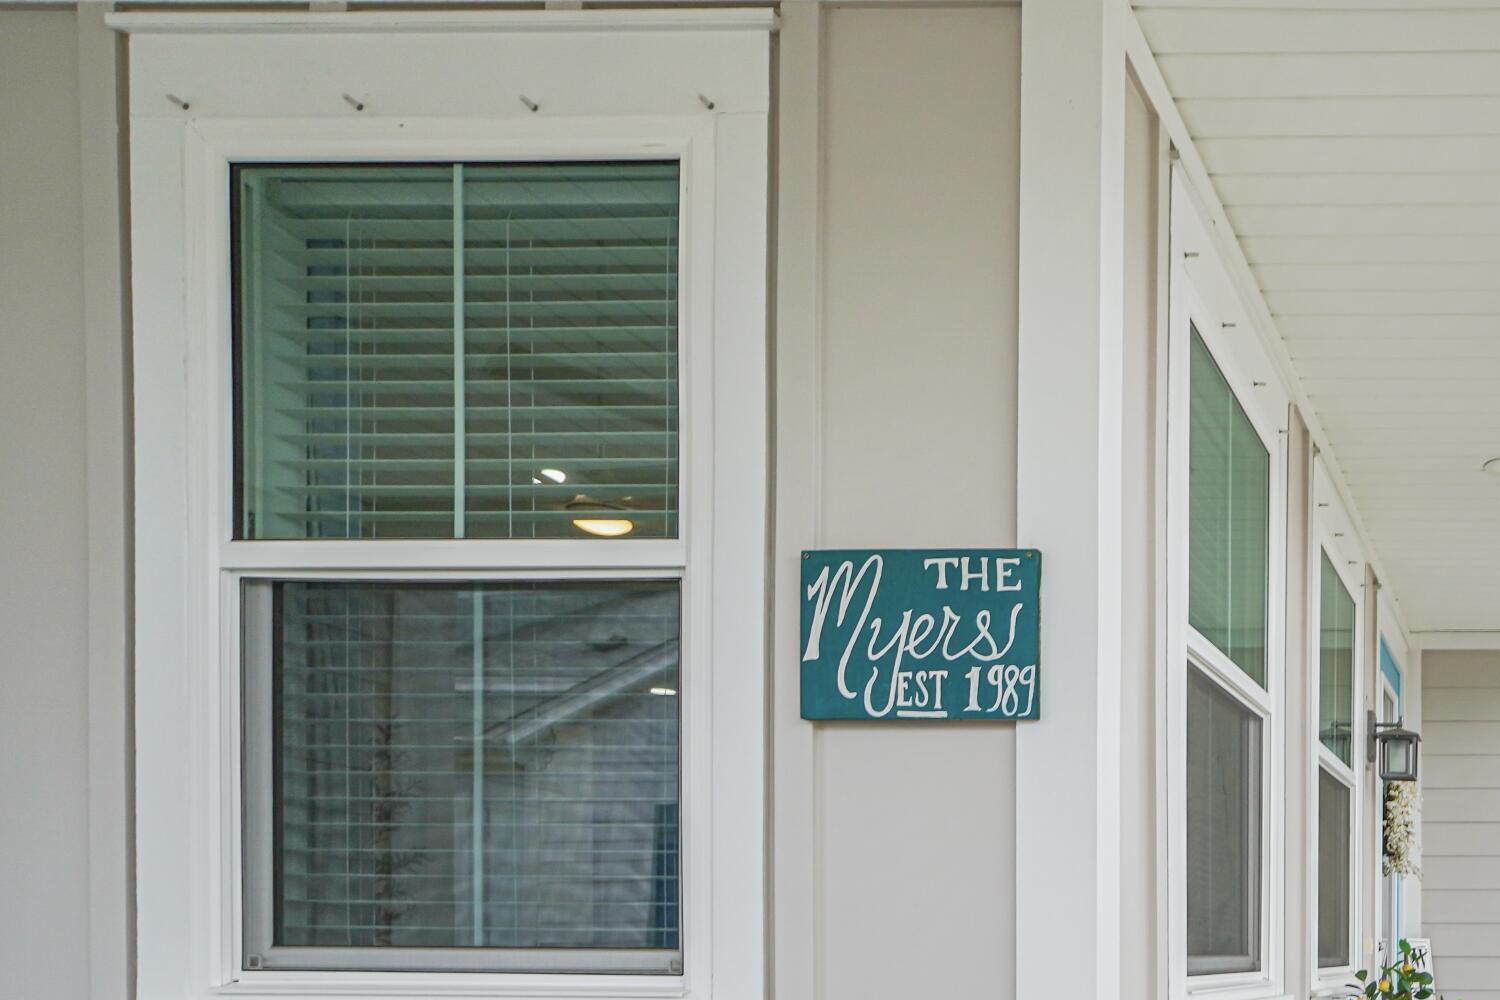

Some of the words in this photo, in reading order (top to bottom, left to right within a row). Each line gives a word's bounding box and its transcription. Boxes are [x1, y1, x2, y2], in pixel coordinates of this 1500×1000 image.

[924, 556, 1023, 593] THE
[802, 554, 1024, 718] Myers
[896, 670, 949, 710] EST
[963, 664, 1037, 718] 1989
